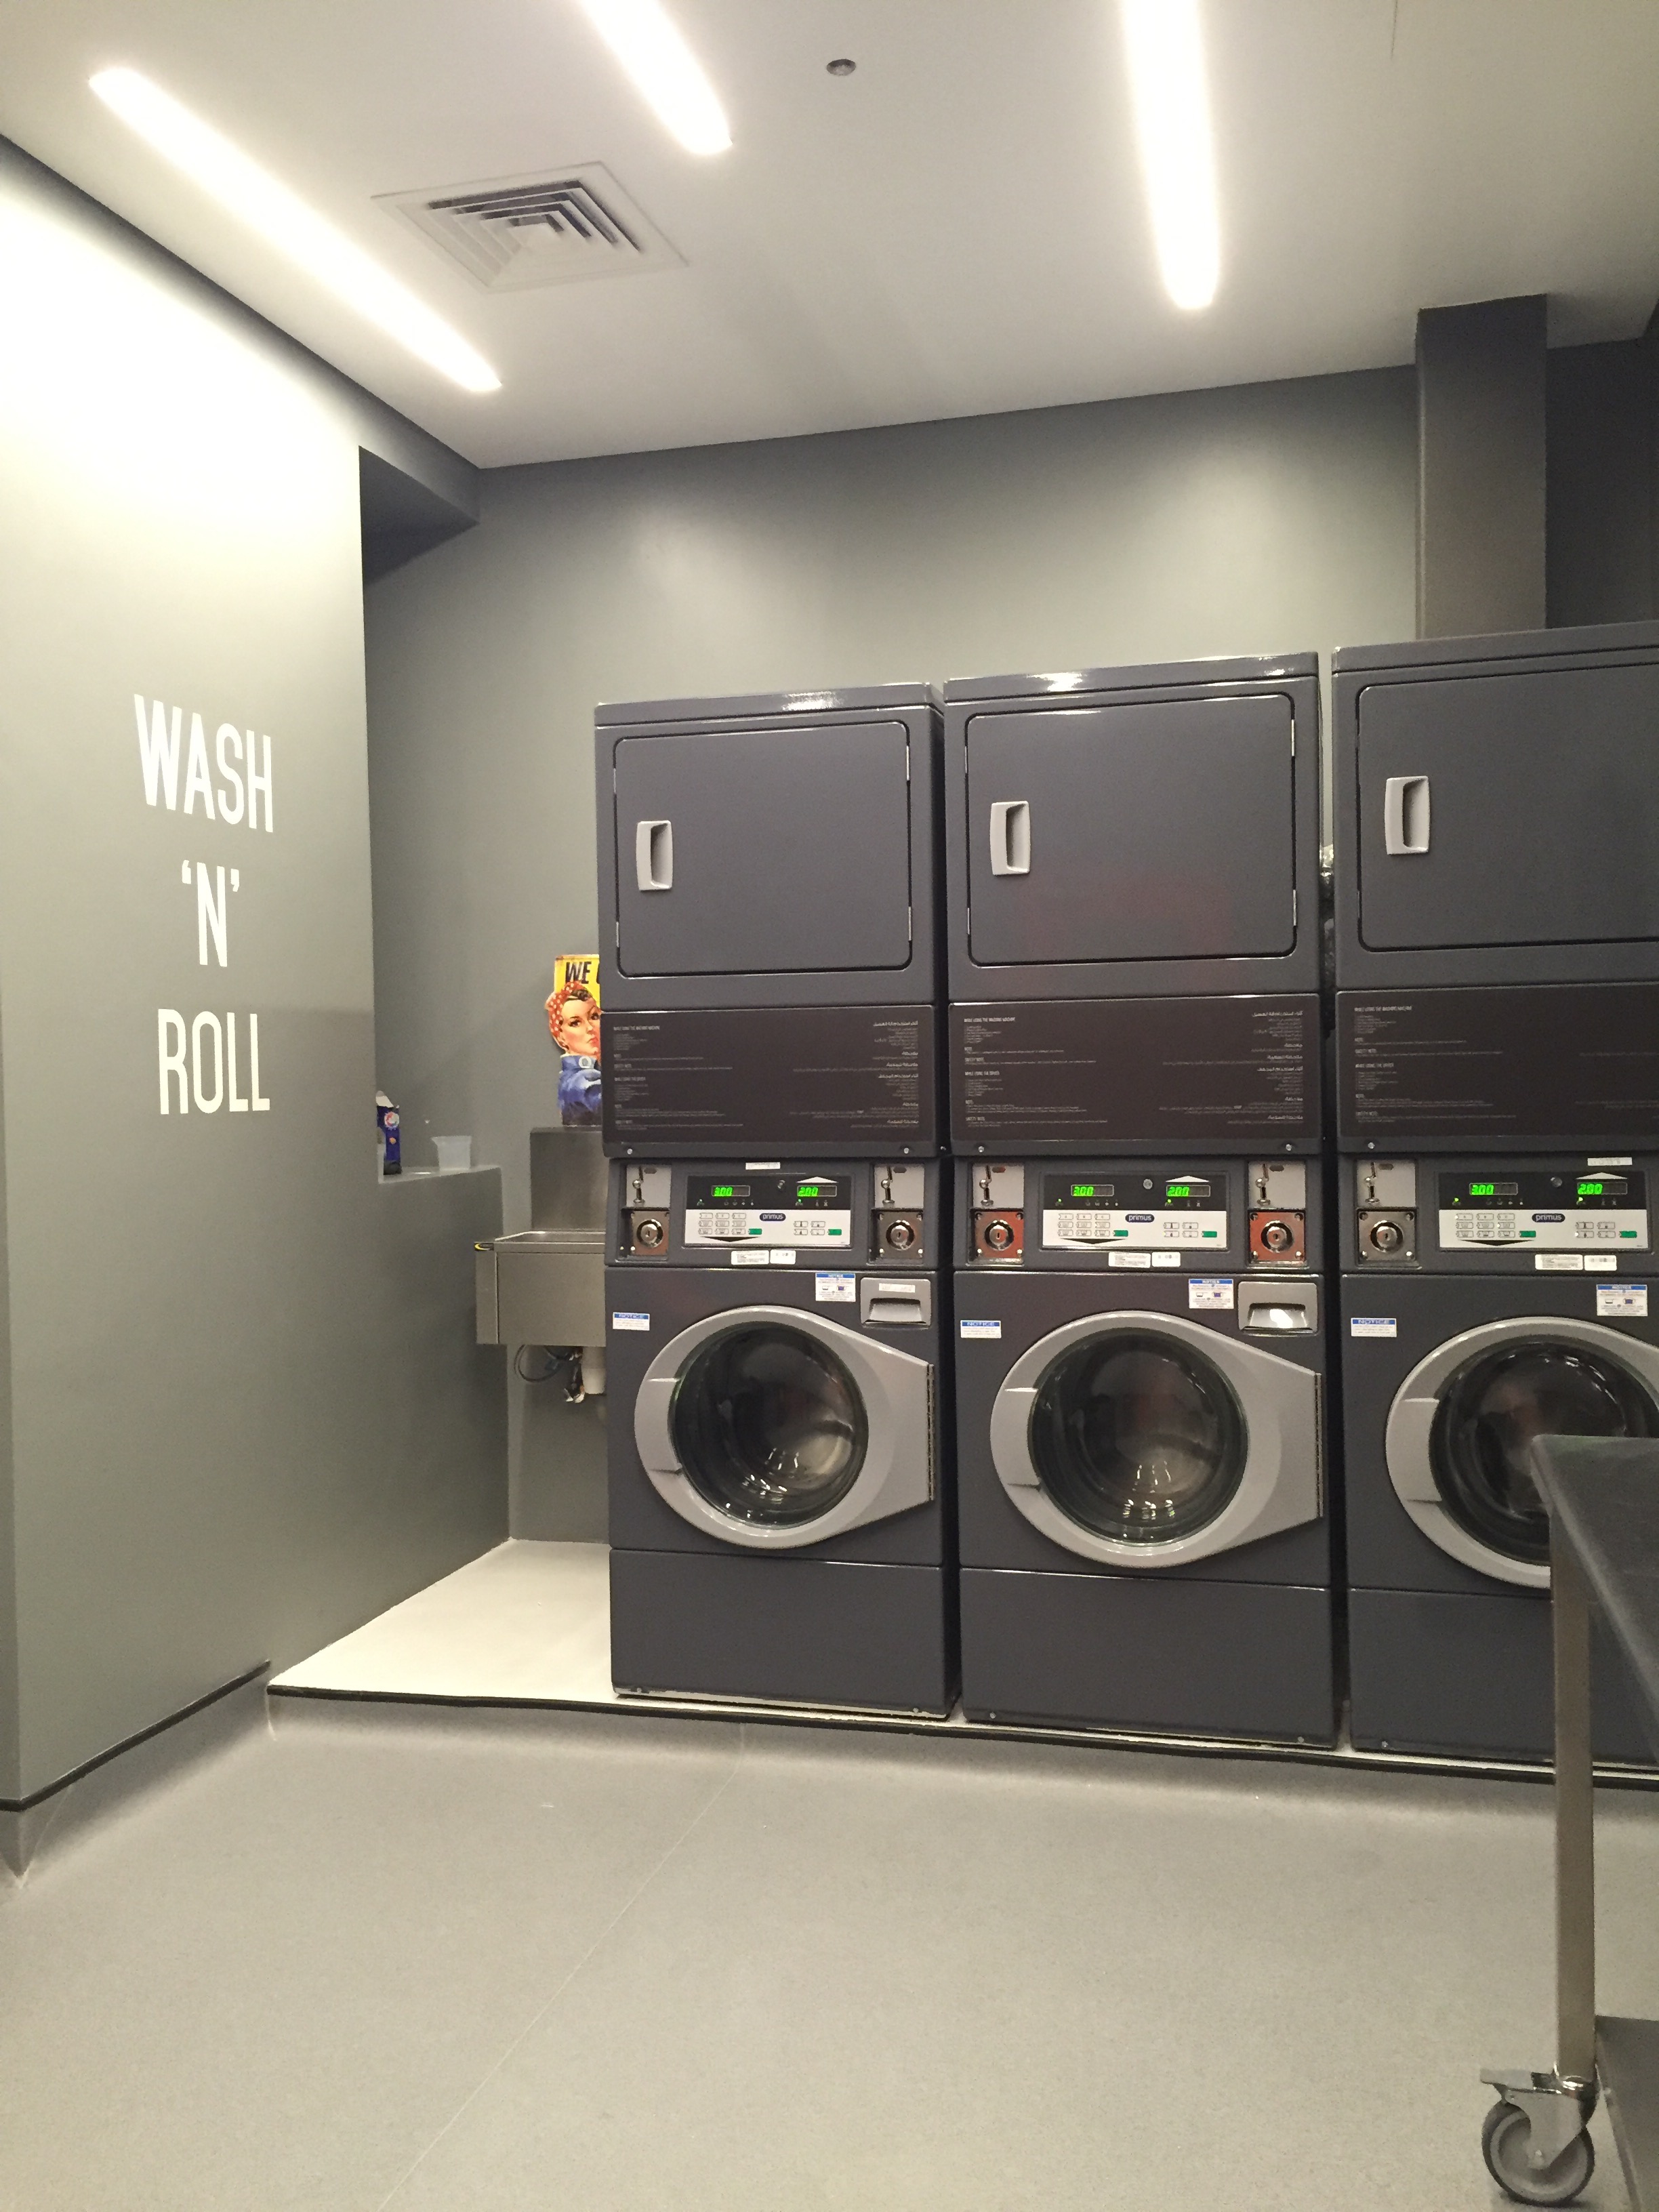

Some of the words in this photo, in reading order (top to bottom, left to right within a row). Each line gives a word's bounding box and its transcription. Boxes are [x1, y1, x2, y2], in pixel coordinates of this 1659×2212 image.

[134, 694, 274, 833] WASH
[565, 961, 592, 984] WE
[157, 1008, 270, 1115] ROLL
[1128, 1214, 1151, 1222] primus
